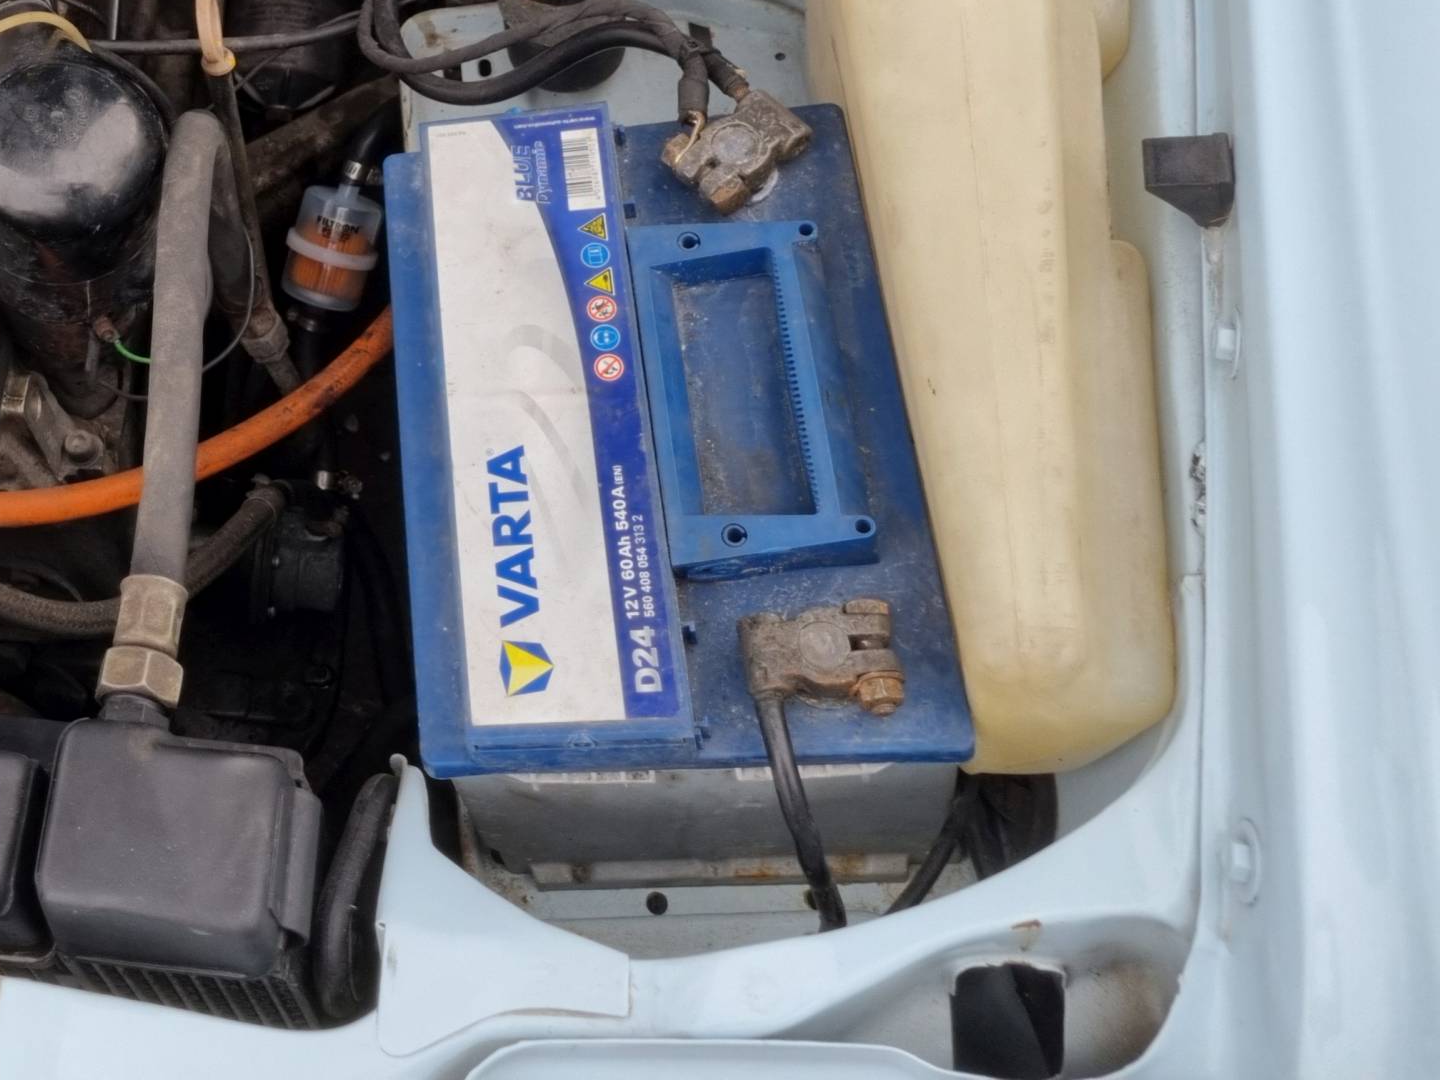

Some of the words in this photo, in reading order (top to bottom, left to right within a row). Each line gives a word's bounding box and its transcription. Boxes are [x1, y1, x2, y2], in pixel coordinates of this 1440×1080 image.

[512, 145, 535, 200] BLUE
[532, 140, 553, 205] Dynamic
[632, 514, 643, 522] 2
[486, 444, 540, 629] VARTA
[633, 524, 646, 545] 313
[635, 547, 649, 569] 054
[639, 571, 652, 593] 408
[642, 595, 656, 618] 560
[629, 626, 663, 693] D24
